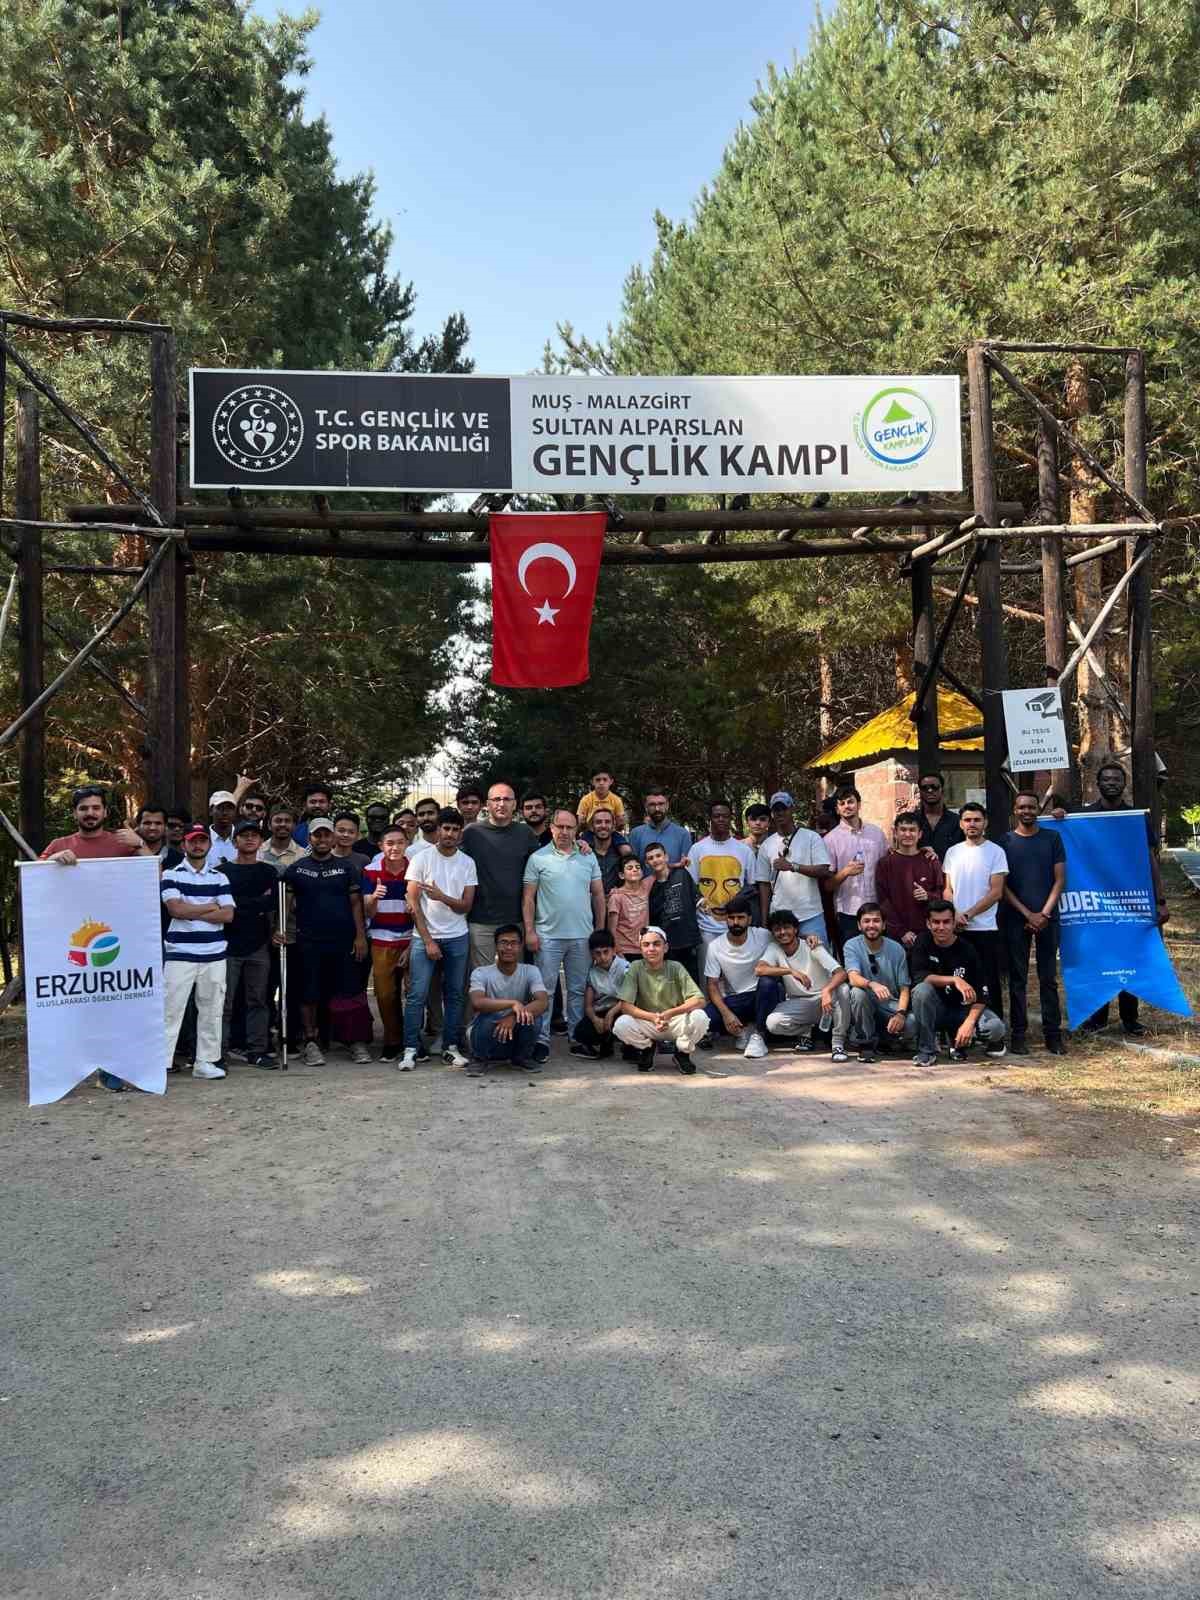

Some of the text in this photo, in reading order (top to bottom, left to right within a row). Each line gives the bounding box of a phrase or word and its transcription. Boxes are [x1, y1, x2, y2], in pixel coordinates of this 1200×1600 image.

[532, 394, 572, 413] MUŞ
[587, 392, 692, 410] MALAZGİRT
[315, 407, 489, 432] T.C. GENÇLİK VE
[532, 418, 743, 437] SULTAN ALPARSLAN
[316, 431, 490, 453] SPOR BAKANLIĞI
[533, 437, 849, 485] GENÇLİK KAMPI
[36, 966, 153, 999] ERZURUM
